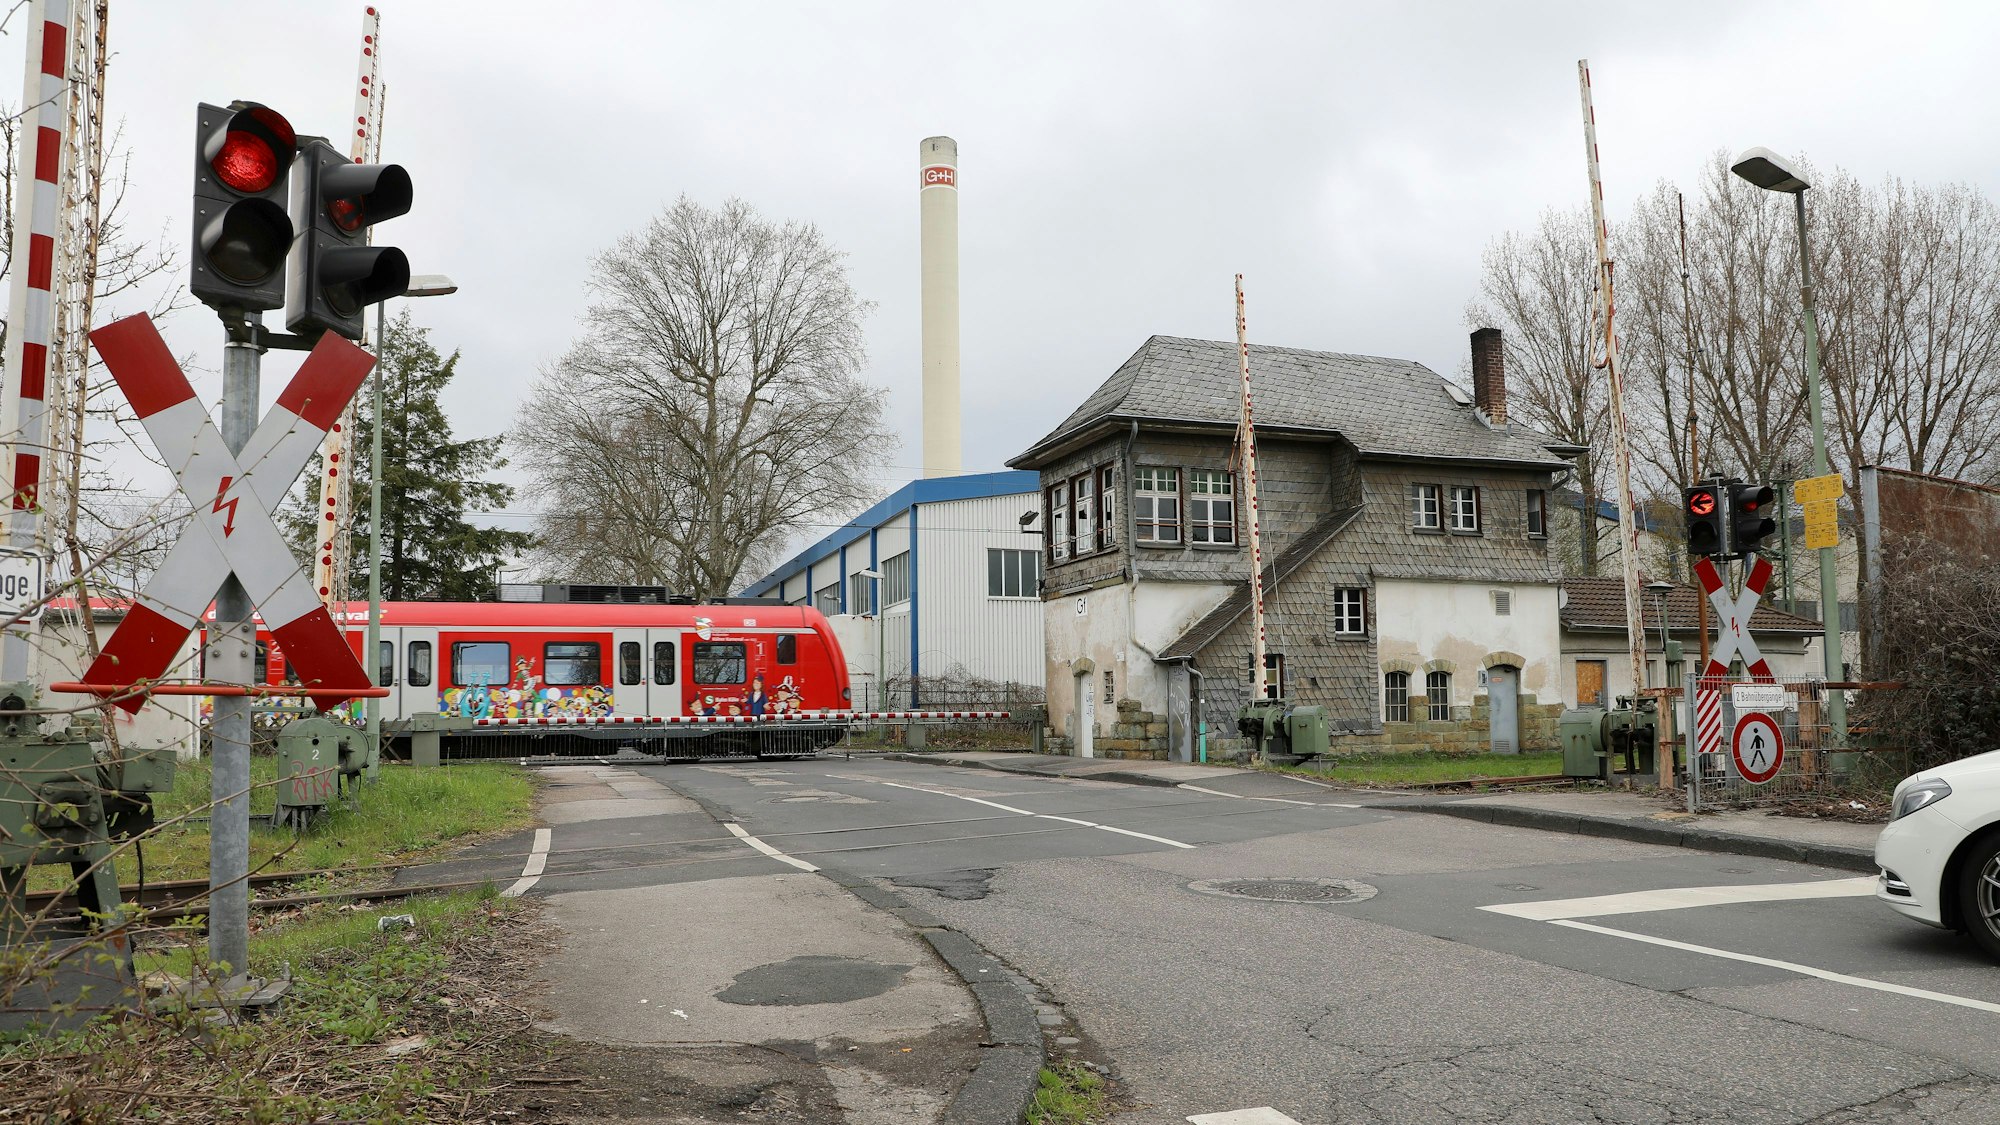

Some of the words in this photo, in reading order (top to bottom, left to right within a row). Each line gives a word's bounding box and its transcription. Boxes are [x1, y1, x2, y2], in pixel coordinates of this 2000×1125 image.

[926, 169, 954, 184] G+H
[0, 574, 28, 601] ge
[1076, 597, 1087, 614] Gf
[1736, 691, 1740, 702] 2
[1741, 691, 1782, 704] Bahnübergänge
[312, 749, 320, 760] 2
